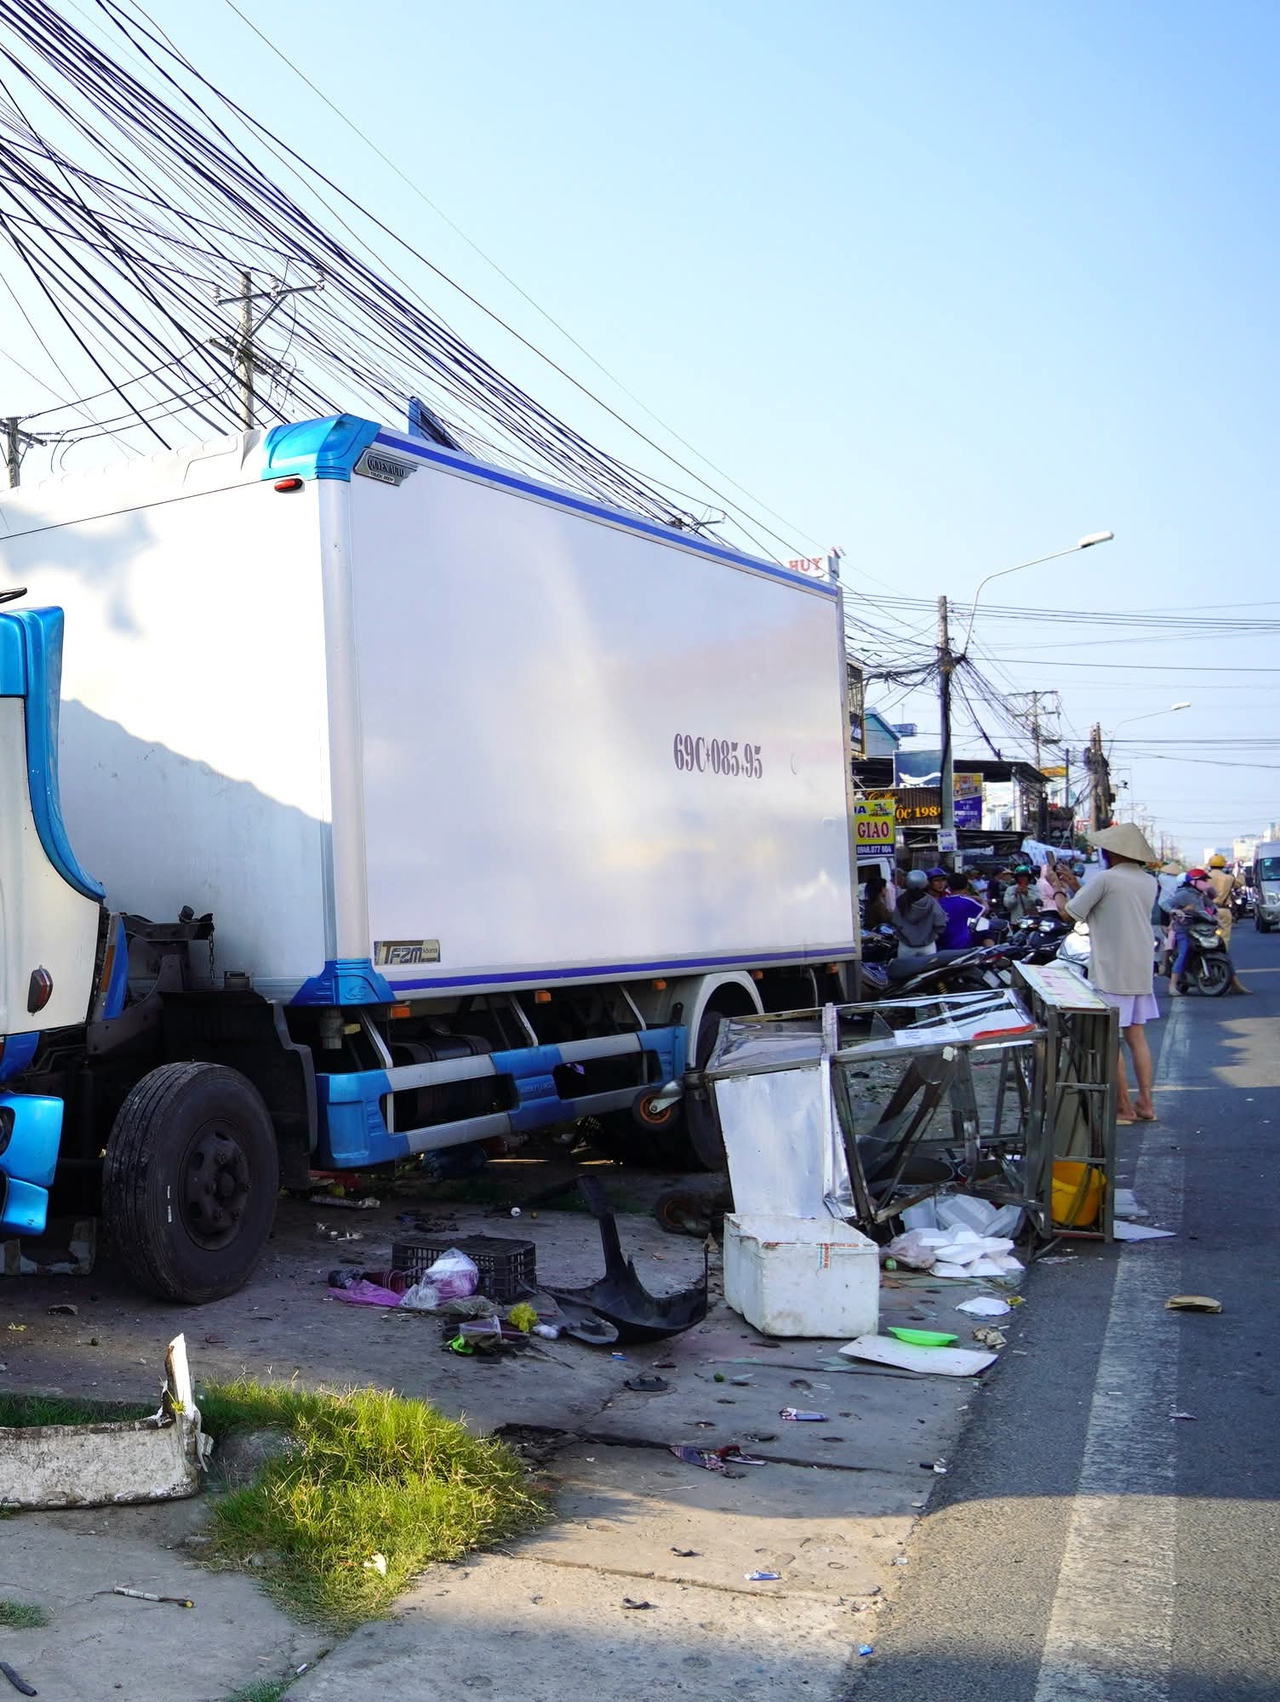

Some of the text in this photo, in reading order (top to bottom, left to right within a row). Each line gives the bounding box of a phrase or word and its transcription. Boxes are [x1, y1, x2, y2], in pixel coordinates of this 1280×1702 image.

[788, 557, 823, 571] HUY
[915, 805, 941, 819] 198
[857, 821, 890, 839] GIAO
